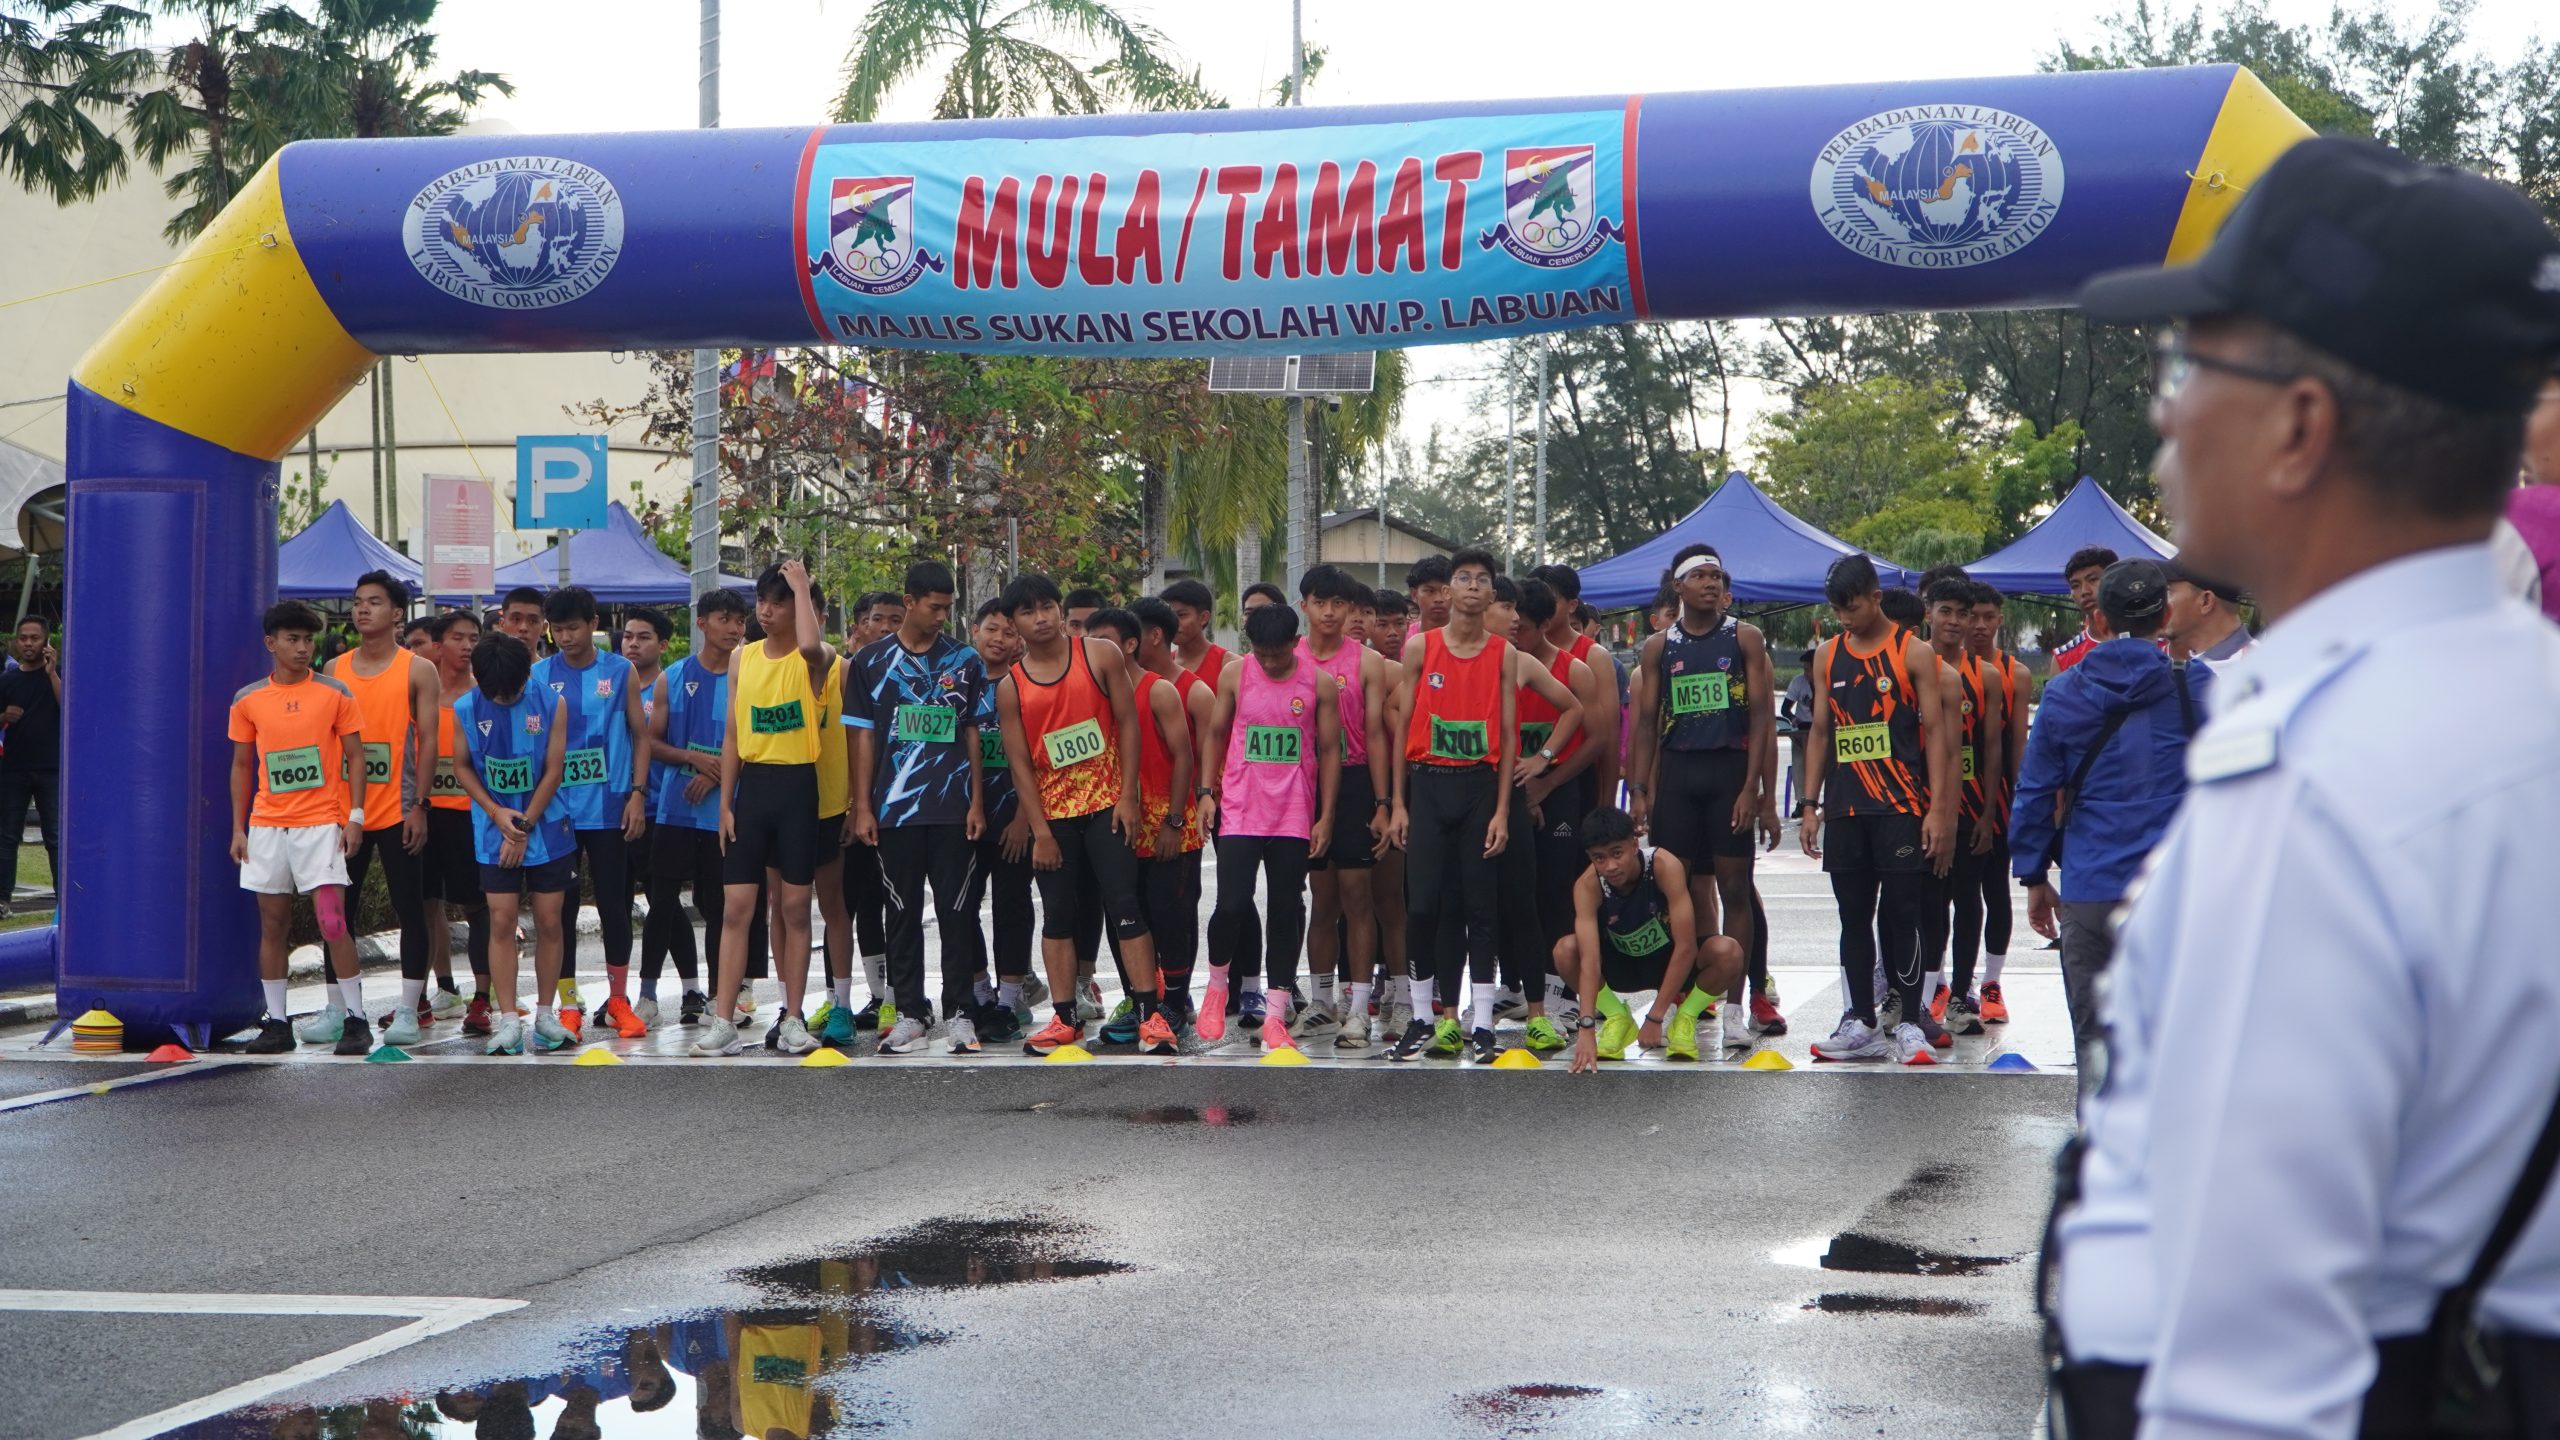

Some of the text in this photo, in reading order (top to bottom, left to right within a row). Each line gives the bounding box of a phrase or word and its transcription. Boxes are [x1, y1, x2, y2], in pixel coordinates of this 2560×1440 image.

[1820, 105, 2055, 166] PERBADANAN LABUAN
[412, 157, 617, 212] PERBADANAN LABUAN
[1879, 188, 1940, 201] MALAYSIA
[953, 151, 1483, 290] MULA/TAMAT
[1820, 199, 2057, 268] LABUAN CORPORATION
[462, 233, 515, 245] MALAYSIA
[1507, 237, 1600, 266] LABUAN CEMERLANG
[411, 244, 618, 309] LABUAN CORPORATION
[833, 267, 920, 294] LABUAN CEMERLANG
[836, 285, 1622, 344] MAJLIS SUKAN SEKOLAH W.P. LABUAN
[531, 447, 593, 518] P
[1677, 683, 1723, 706] M518
[756, 704, 799, 725] L201
[905, 711, 953, 736] W827
[1055, 731, 1100, 763] J800
[1248, 731, 1297, 757] A112
[1435, 723, 1484, 756] K701
[1838, 734, 1886, 756] R601
[271, 765, 319, 786] T602
[488, 765, 529, 790] Y341
[1614, 928, 1662, 953] M522
